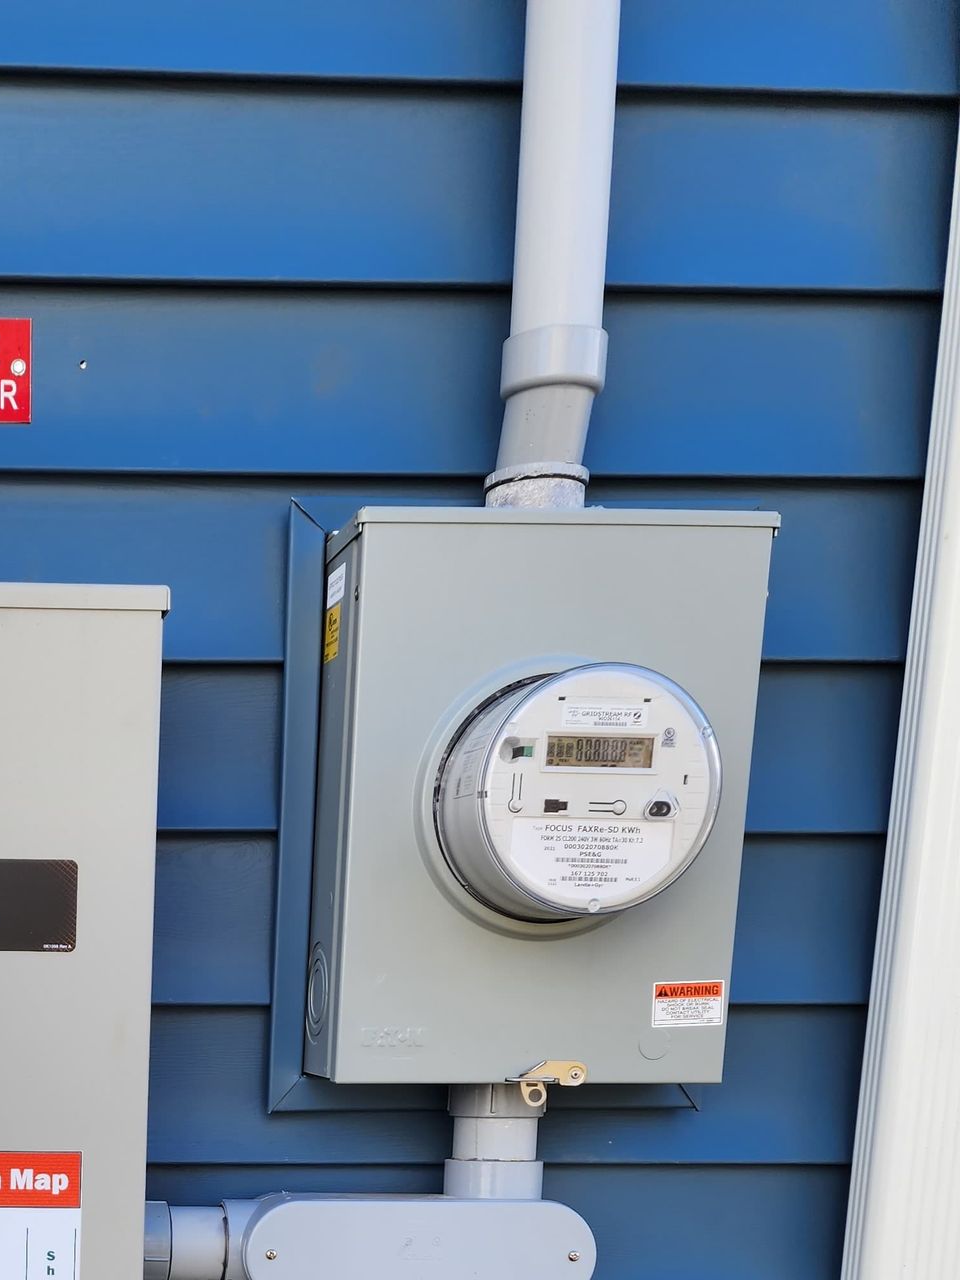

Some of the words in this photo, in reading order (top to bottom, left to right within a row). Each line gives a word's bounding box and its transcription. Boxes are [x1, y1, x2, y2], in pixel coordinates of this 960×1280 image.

[577, 825, 619, 834] FAXRe-SD
[621, 826, 641, 834] KWh
[669, 985, 719, 997] WARNING
[9, 1168, 69, 1195] Map
